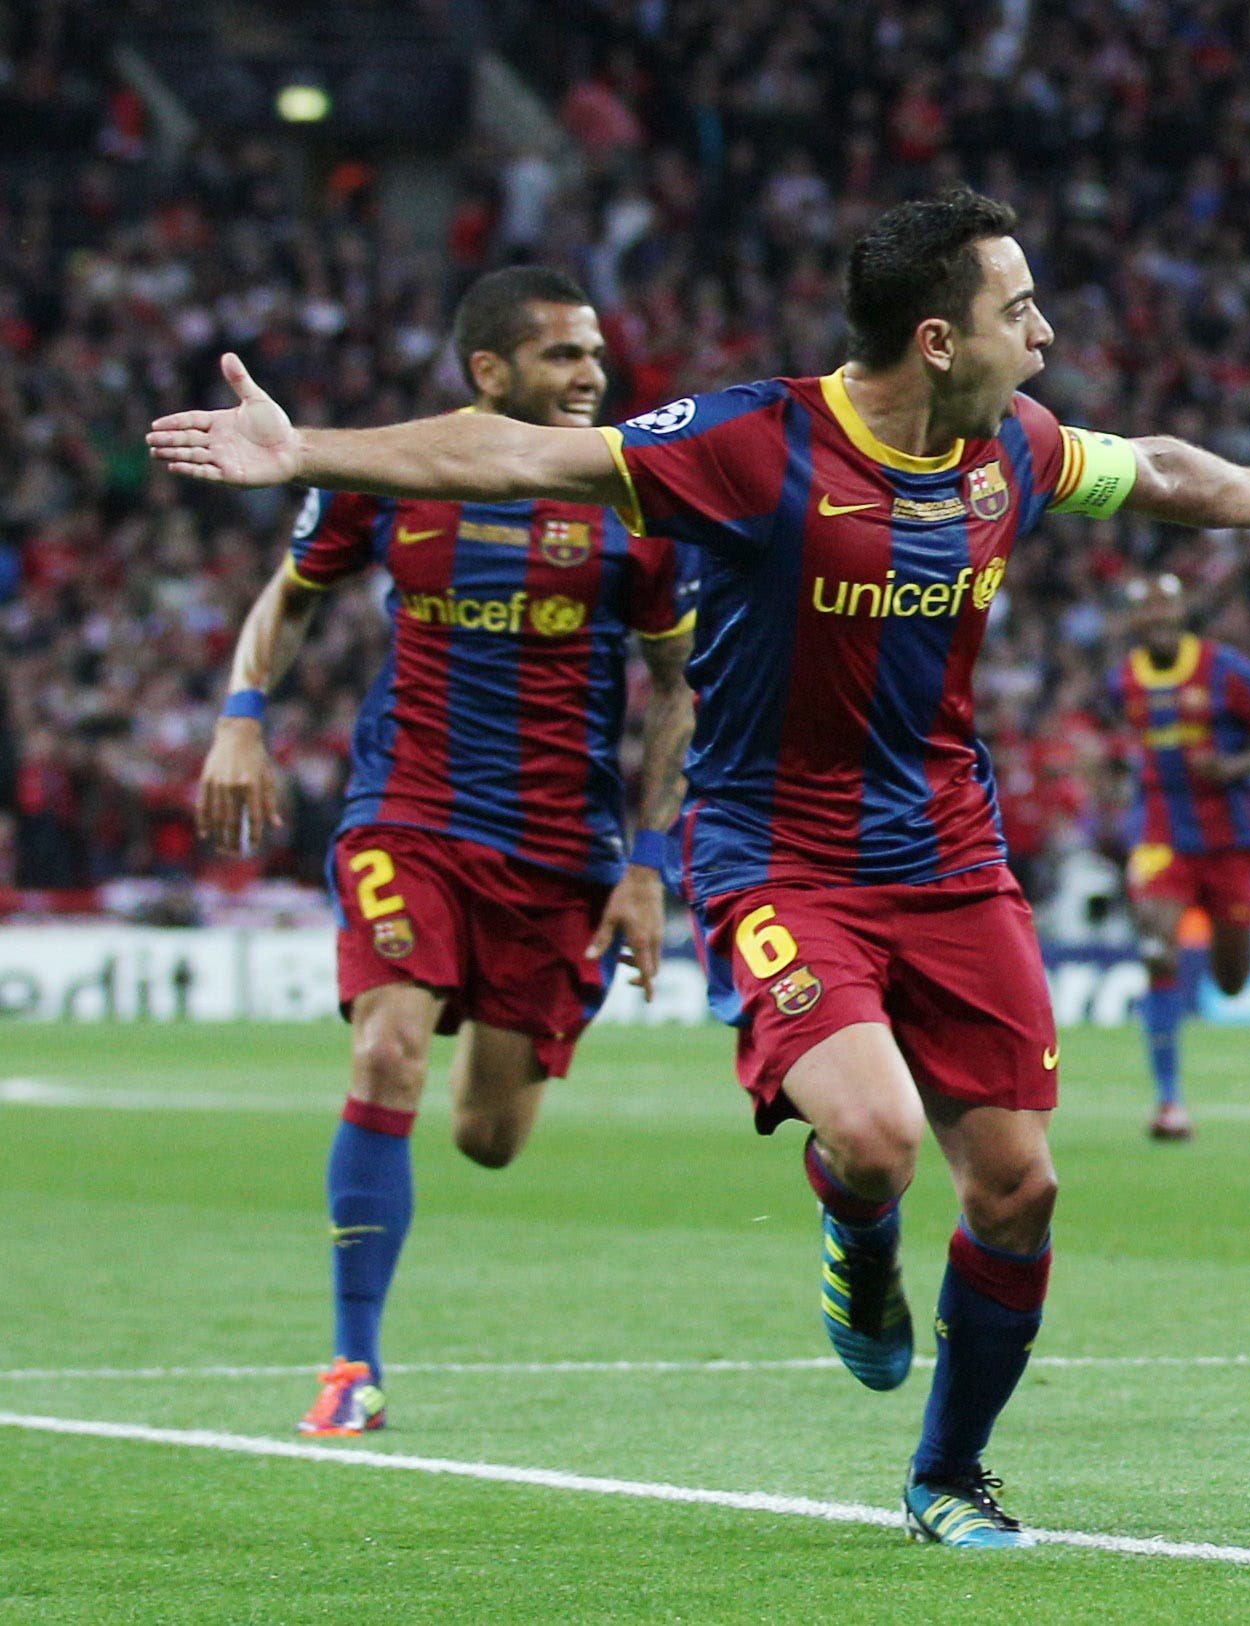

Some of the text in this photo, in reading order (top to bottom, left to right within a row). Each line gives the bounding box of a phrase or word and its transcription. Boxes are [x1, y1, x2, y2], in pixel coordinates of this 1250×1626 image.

[402, 587, 527, 634] unicef
[812, 567, 973, 618] unicef
[349, 848, 406, 920] 2
[735, 904, 798, 979] 6
